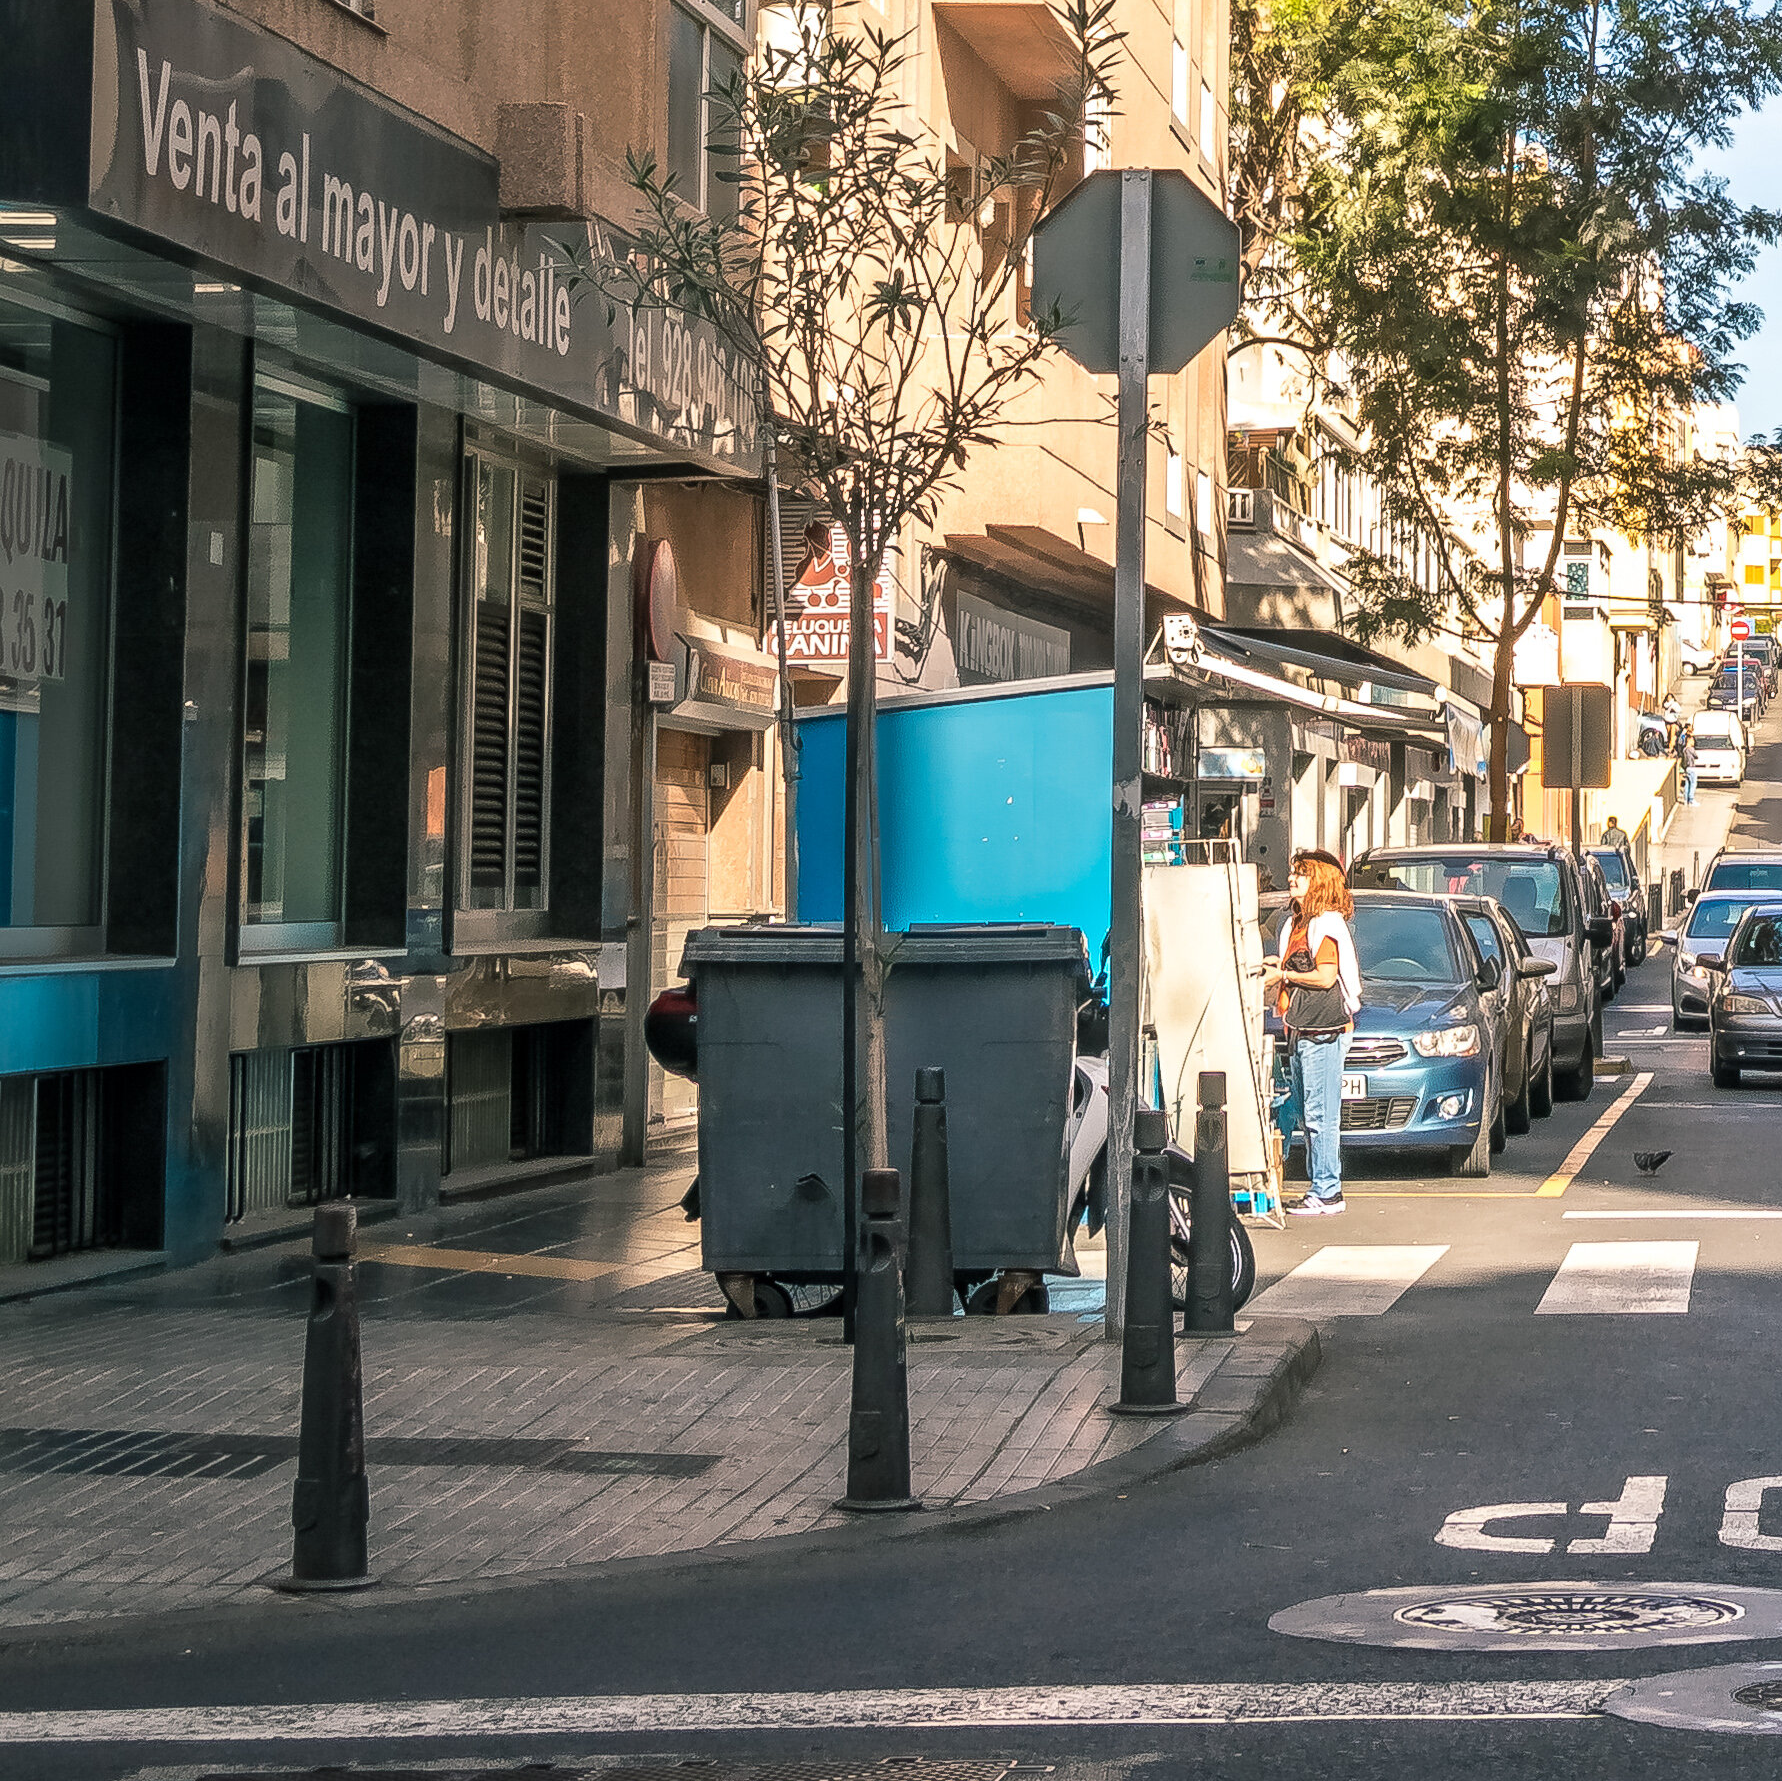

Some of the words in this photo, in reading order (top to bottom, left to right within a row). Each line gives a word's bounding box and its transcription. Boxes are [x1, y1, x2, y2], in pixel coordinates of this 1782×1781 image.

[137, 48, 262, 223] Venta
[276, 132, 310, 244] al
[322, 172, 435, 308] mayor
[444, 232, 464, 334] y
[473, 226, 571, 356] detalle
[661, 319, 692, 412] 928
